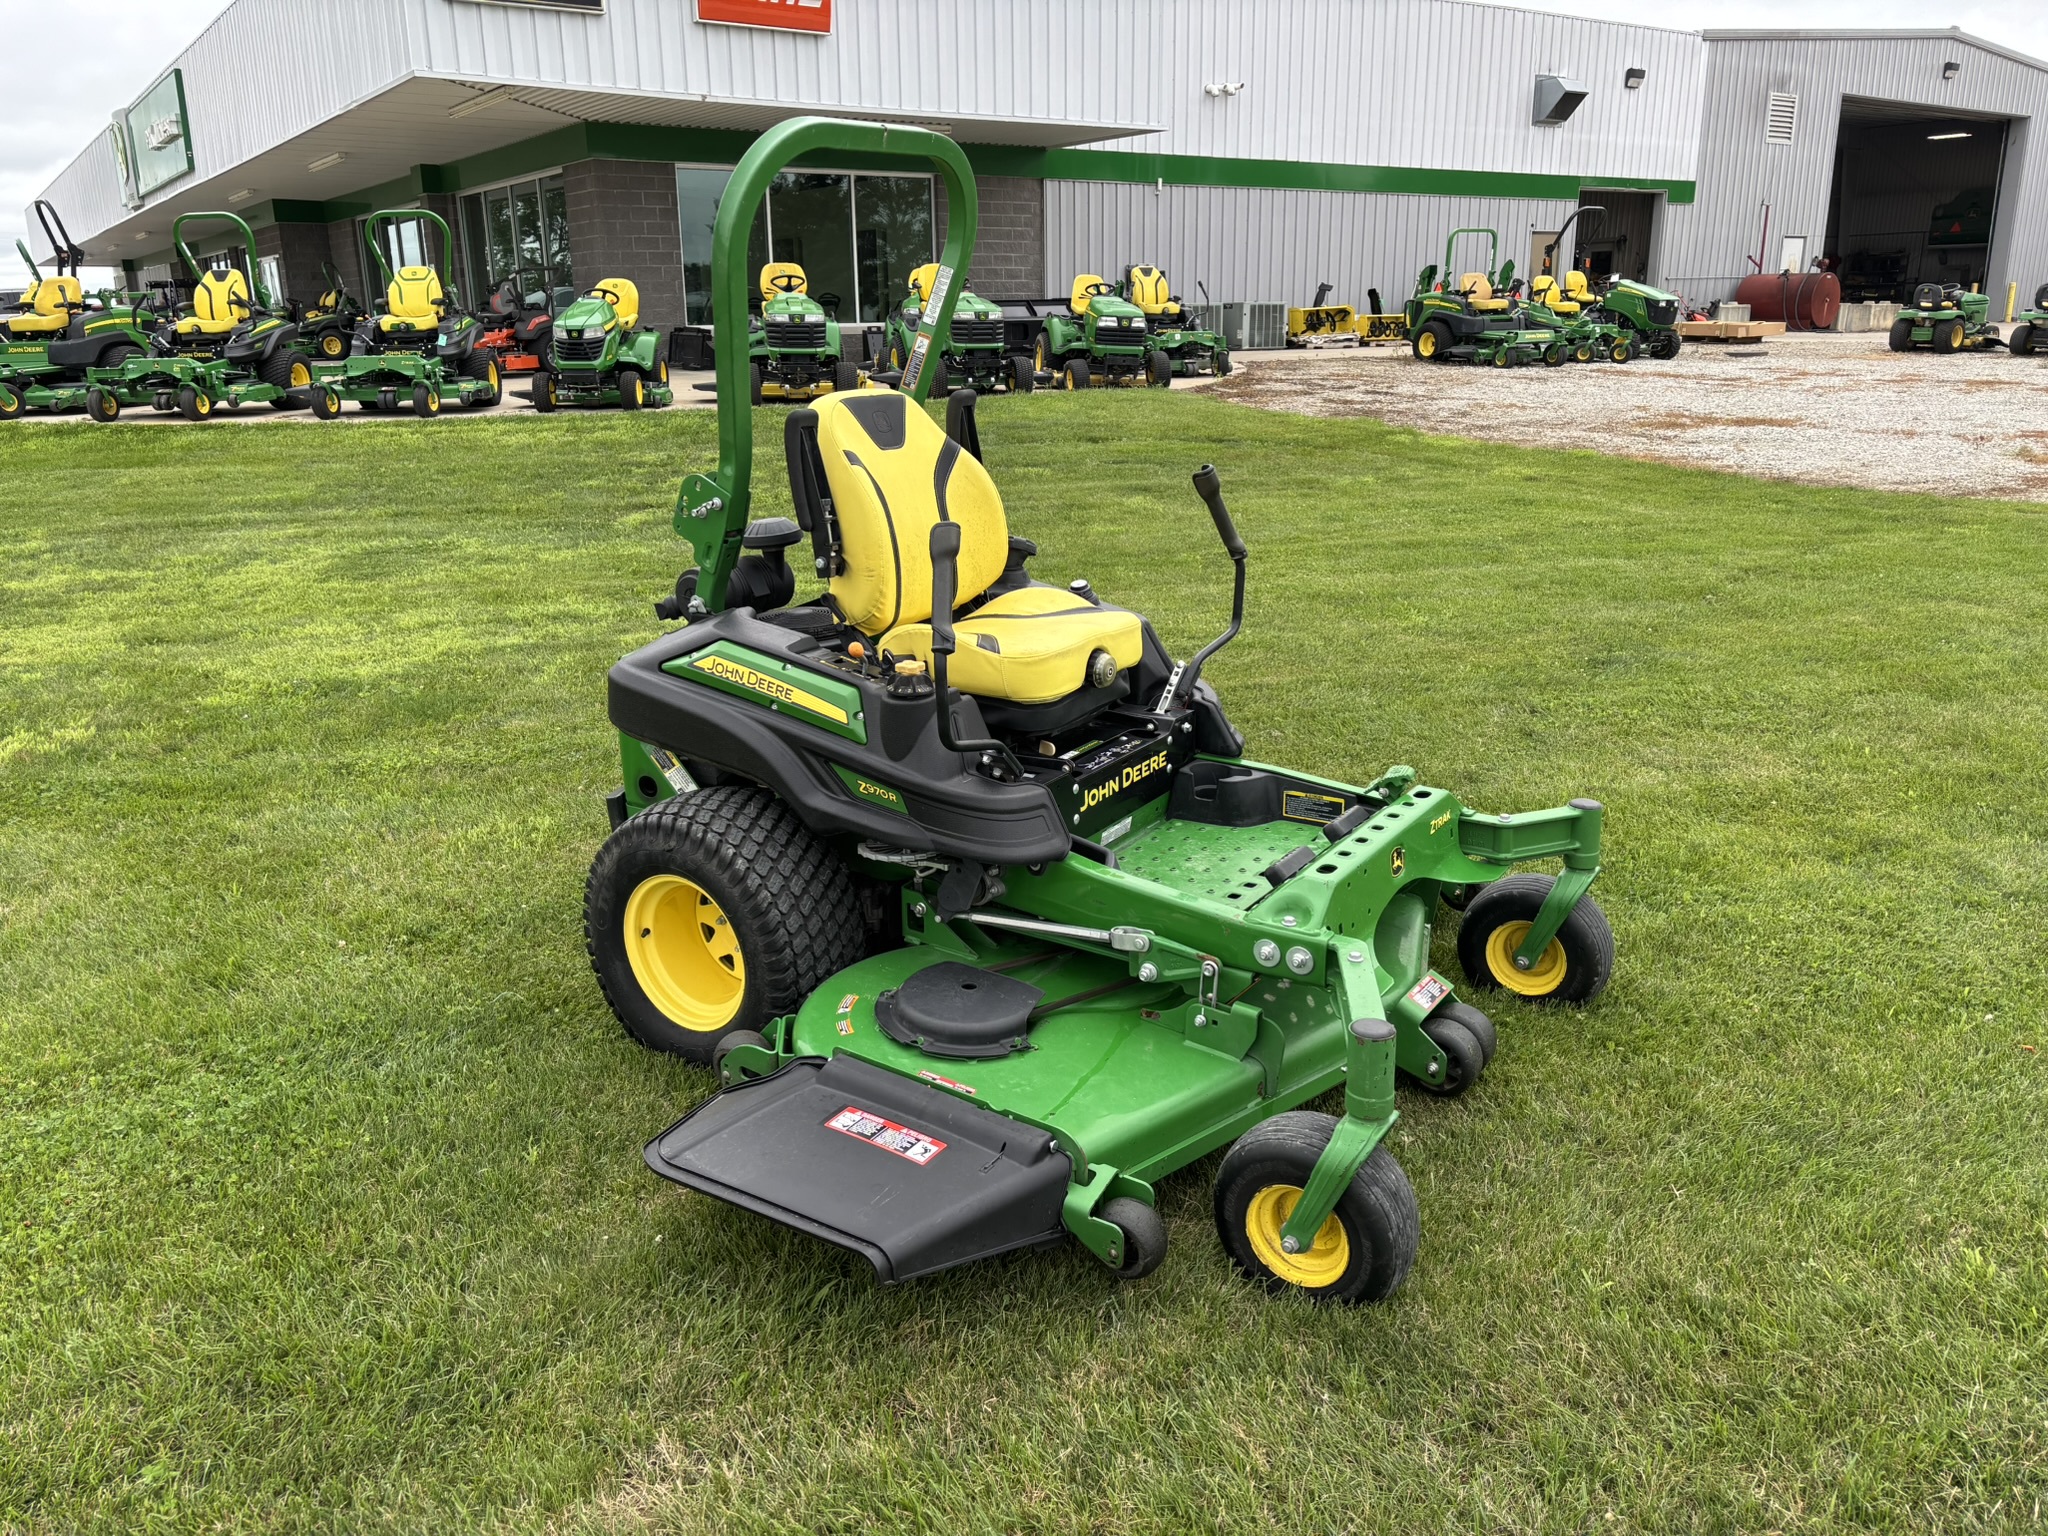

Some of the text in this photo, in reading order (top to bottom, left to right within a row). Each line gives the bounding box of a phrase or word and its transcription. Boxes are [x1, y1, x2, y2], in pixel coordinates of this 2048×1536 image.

[707, 658, 794, 701] JOHN DEERE
[857, 779, 898, 803] Z970R
[1080, 750, 1168, 813] JOHN DEERE
[1429, 808, 1451, 835] ZTRAK
